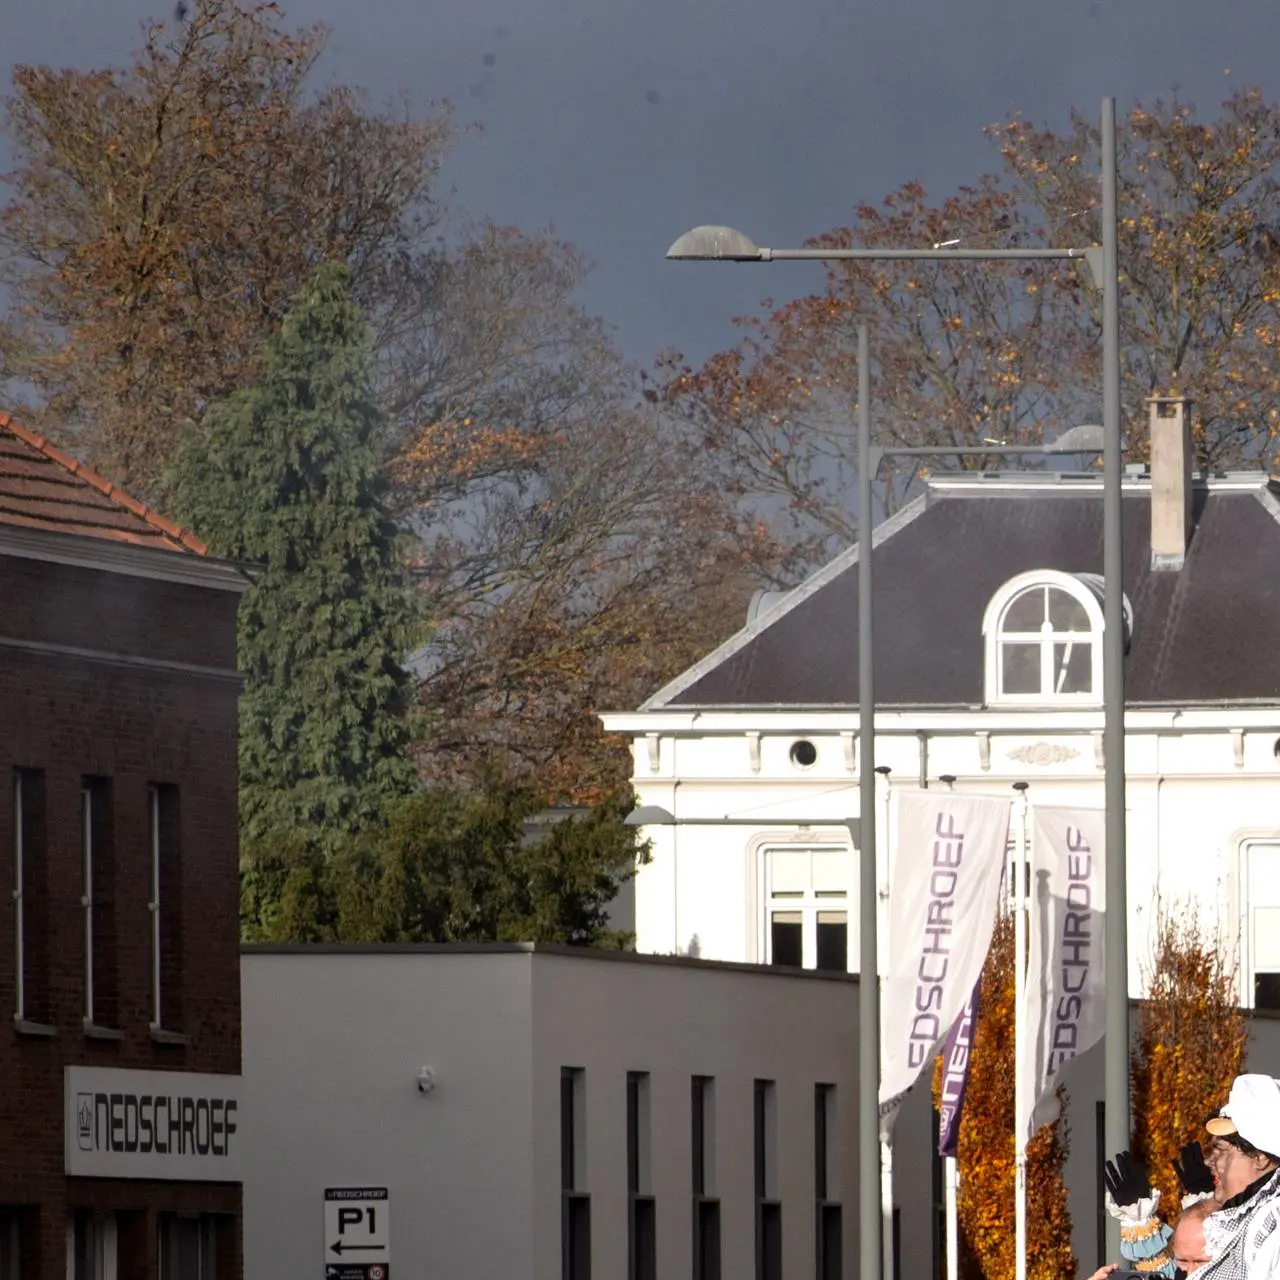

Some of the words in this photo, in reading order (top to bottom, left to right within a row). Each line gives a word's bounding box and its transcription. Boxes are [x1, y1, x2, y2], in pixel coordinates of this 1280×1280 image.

[908, 811, 965, 1069] EDSCHROEF
[1047, 826, 1092, 1076] EDSCHROEF
[95, 1093, 237, 1156] NEDSCHROEF
[338, 1207, 376, 1235] P1
